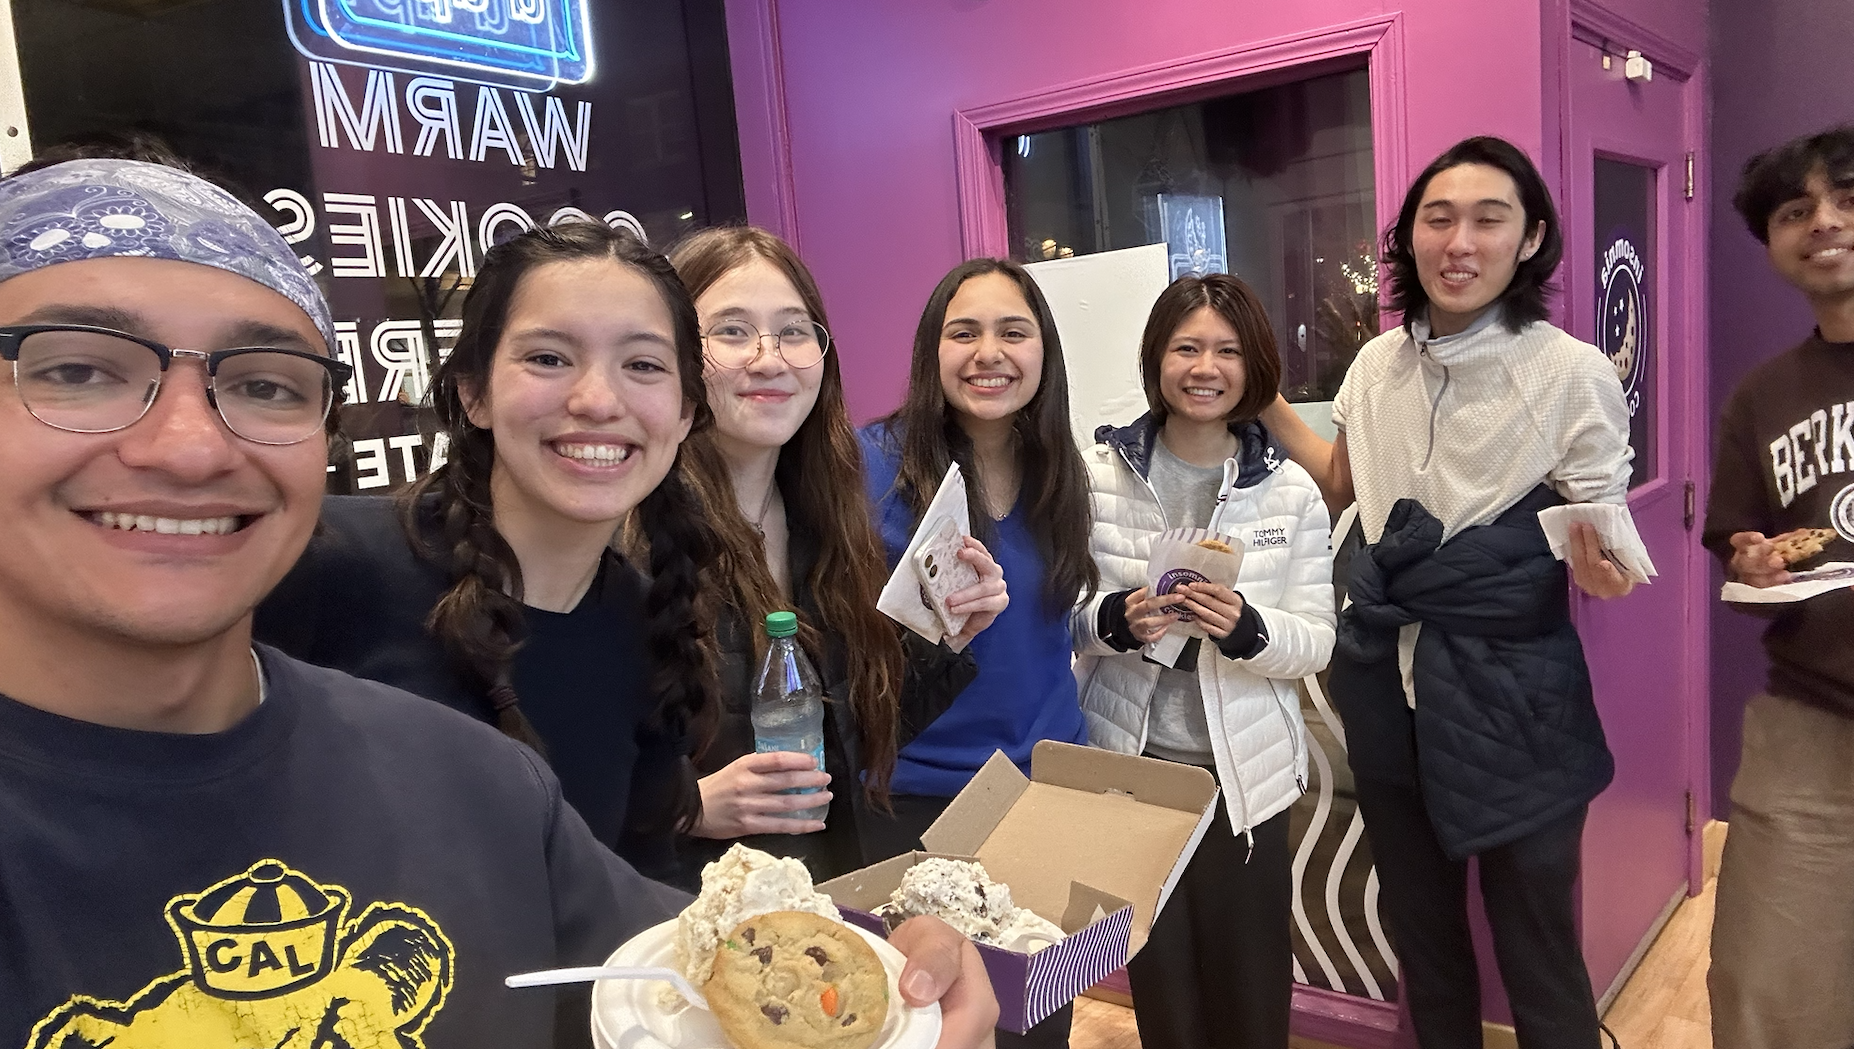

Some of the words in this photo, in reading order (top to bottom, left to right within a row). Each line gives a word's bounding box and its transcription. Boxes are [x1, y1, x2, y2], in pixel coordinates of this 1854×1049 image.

[1253, 528, 1286, 539] TOMMY
[1253, 536, 1287, 547] HILFIGER
[1167, 571, 1209, 583] insomn
[205, 938, 316, 978] CAL
